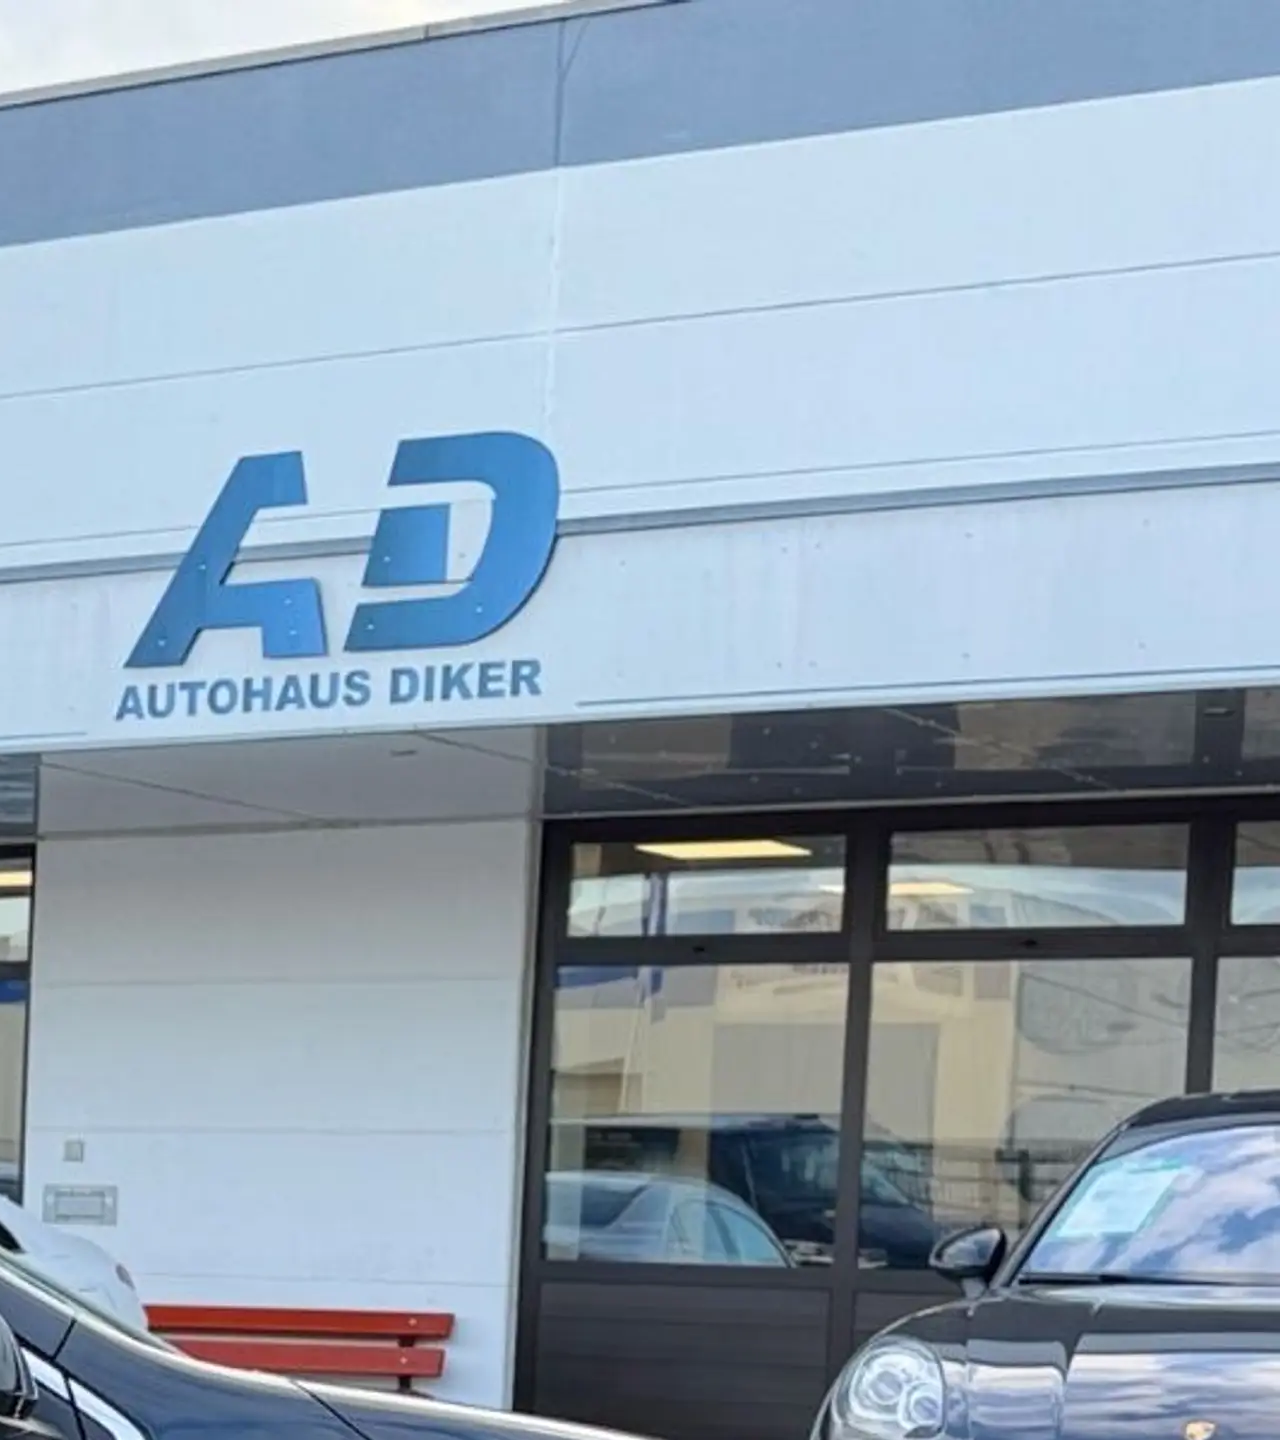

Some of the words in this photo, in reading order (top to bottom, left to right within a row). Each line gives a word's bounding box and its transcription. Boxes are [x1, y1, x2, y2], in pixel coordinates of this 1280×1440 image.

[124, 431, 560, 668] AD
[116, 670, 371, 720] AUTOHAUS
[389, 659, 542, 705] DIKER
